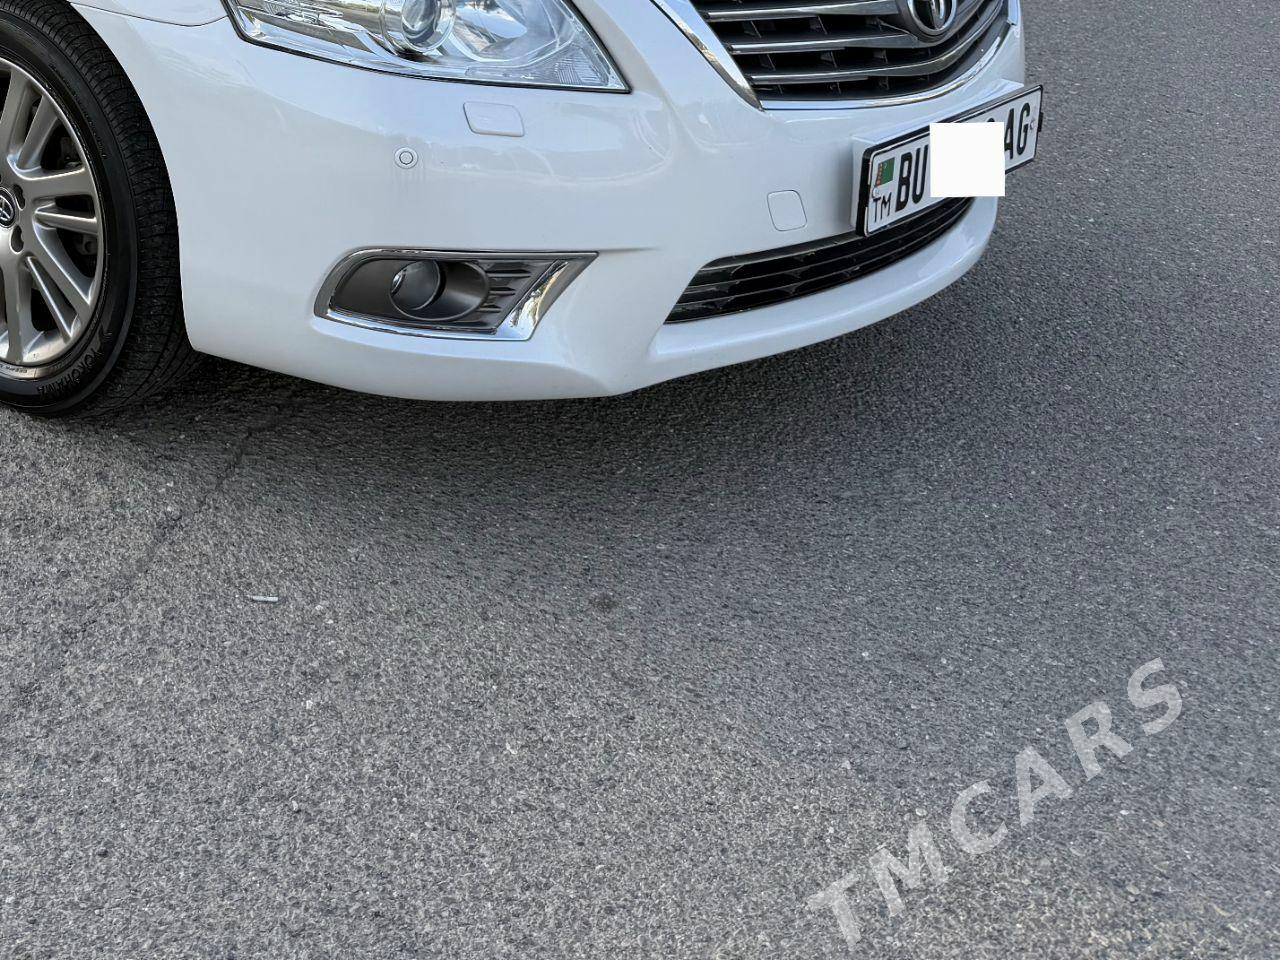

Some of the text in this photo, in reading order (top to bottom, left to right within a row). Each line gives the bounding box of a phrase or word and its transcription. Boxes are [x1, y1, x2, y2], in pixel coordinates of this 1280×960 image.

[894, 102, 1031, 212] BU AG
[872, 192, 892, 223] TM
